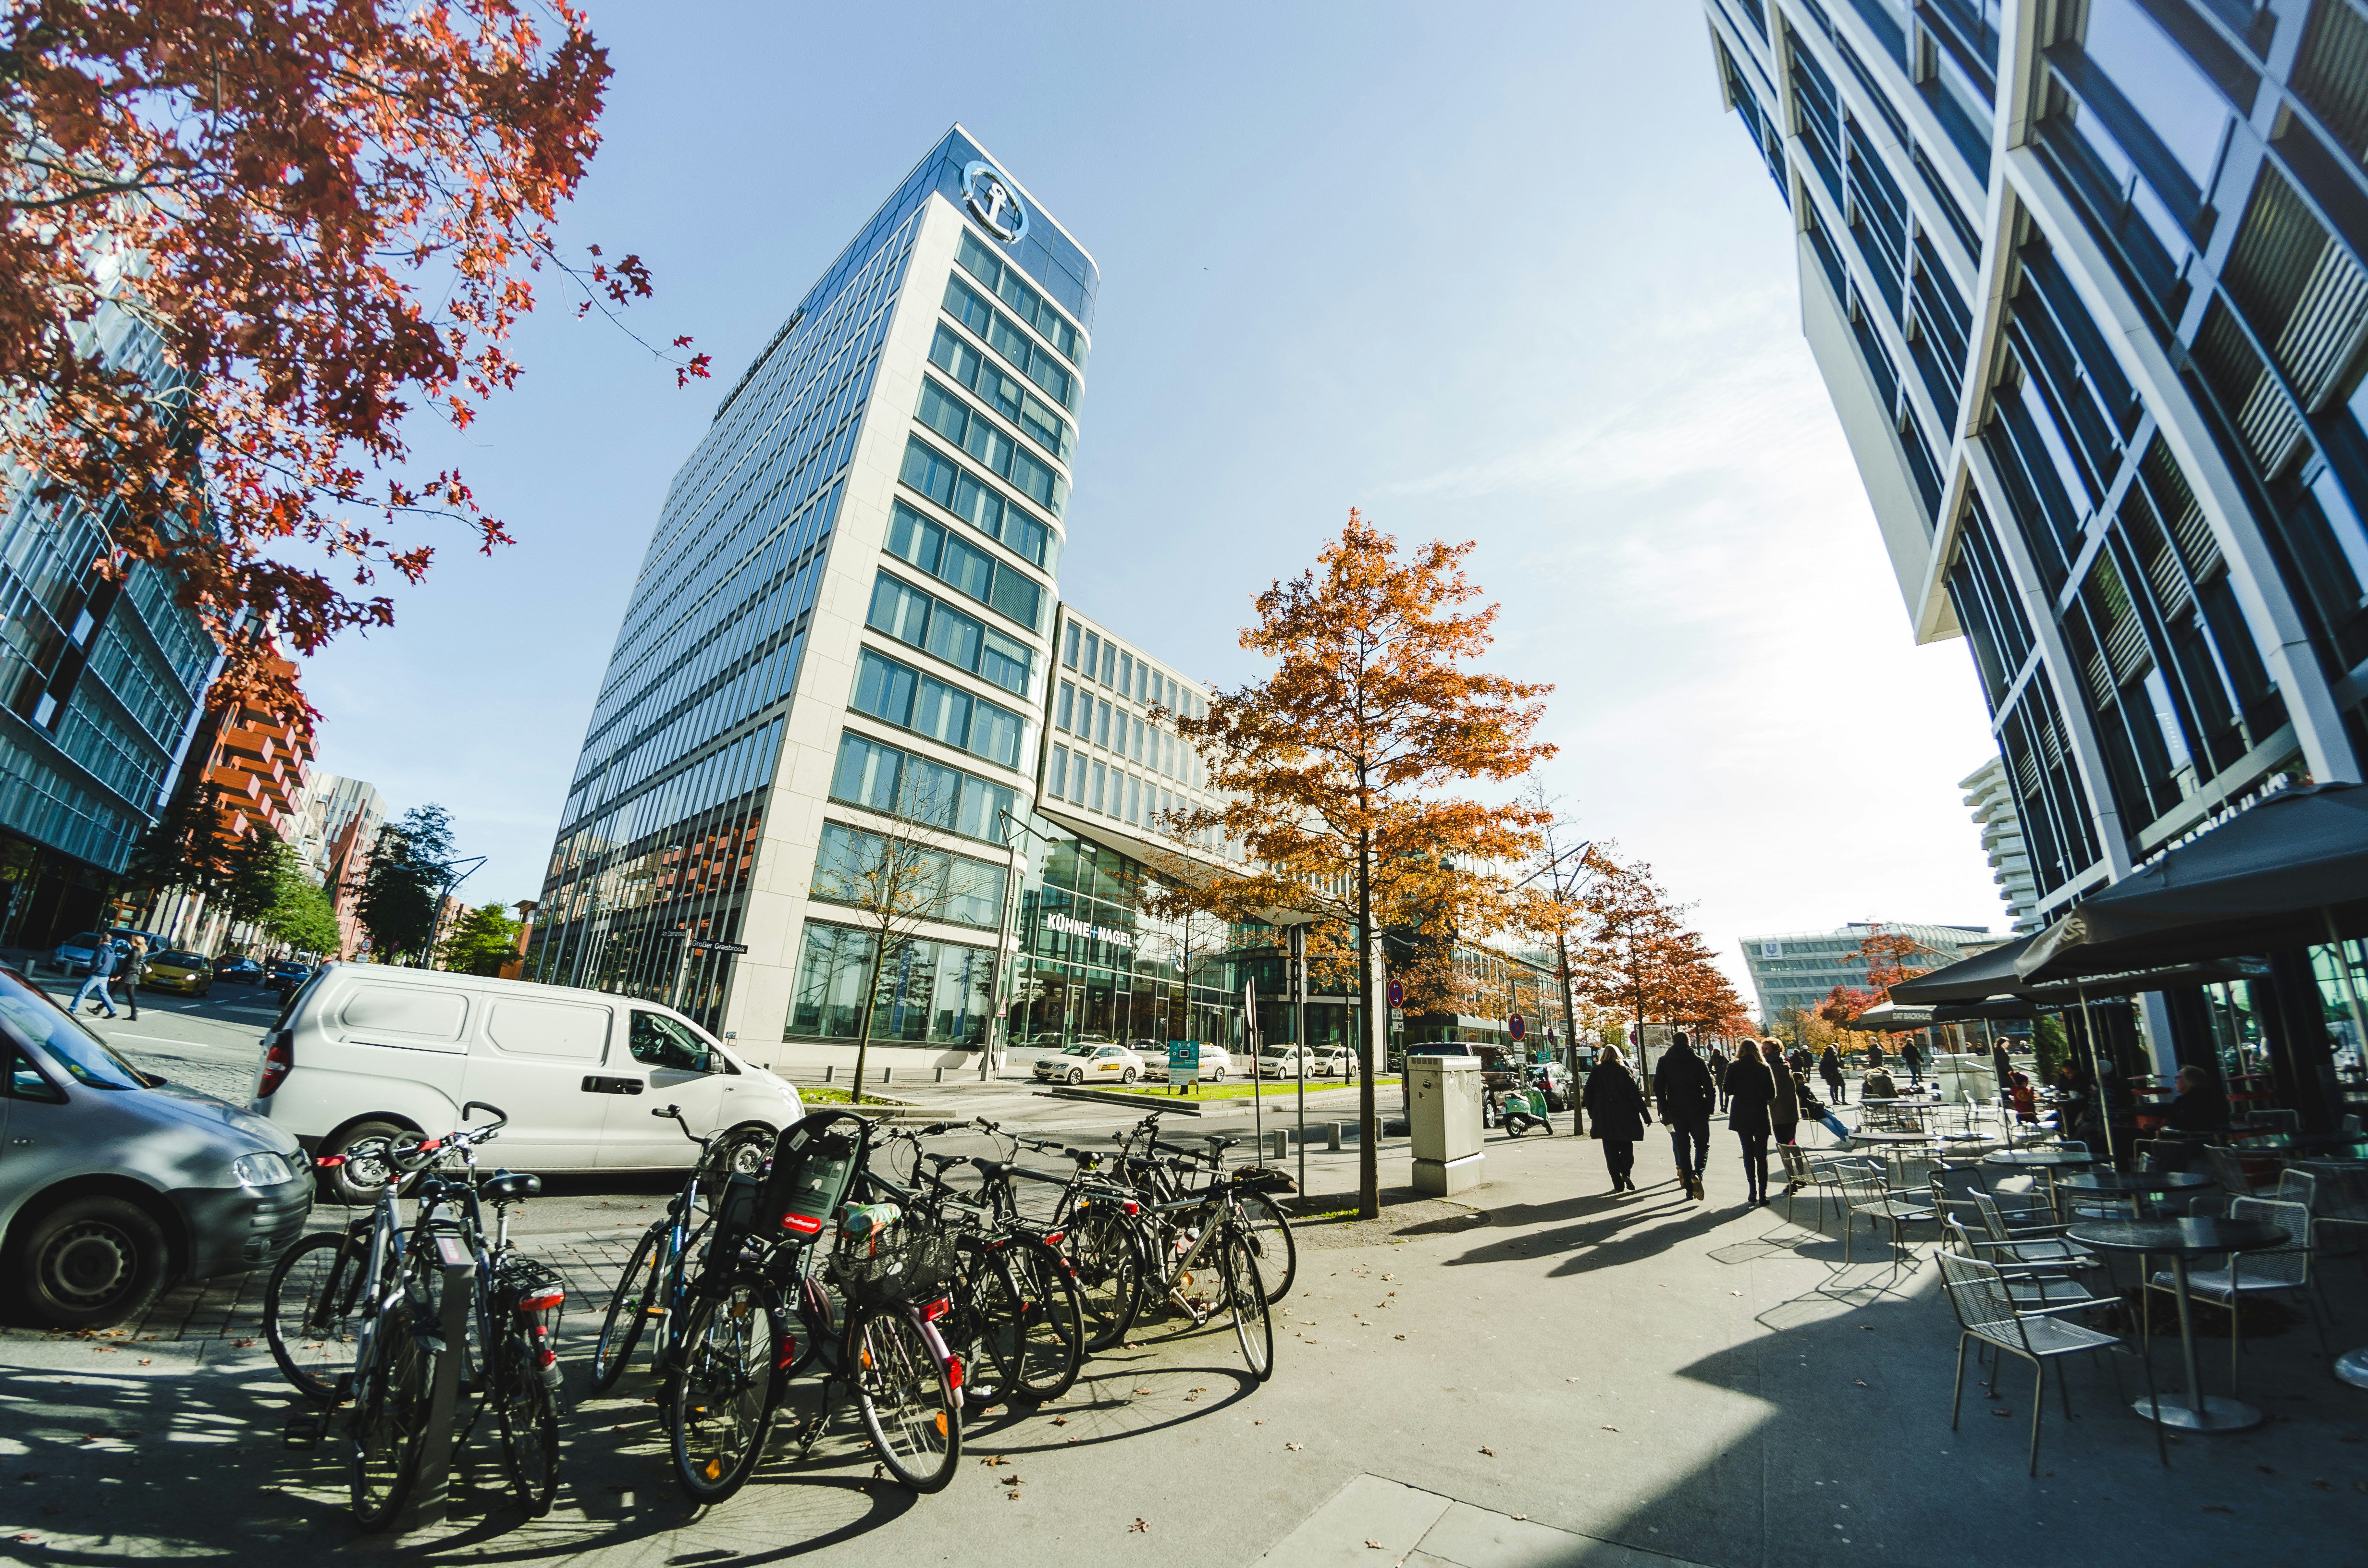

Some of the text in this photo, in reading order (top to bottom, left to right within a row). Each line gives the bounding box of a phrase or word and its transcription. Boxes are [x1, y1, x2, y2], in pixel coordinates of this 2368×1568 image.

[1047, 912, 1133, 948] KÜHNE+NAGEL
[692, 940, 745, 952] Großer Grasbrook
